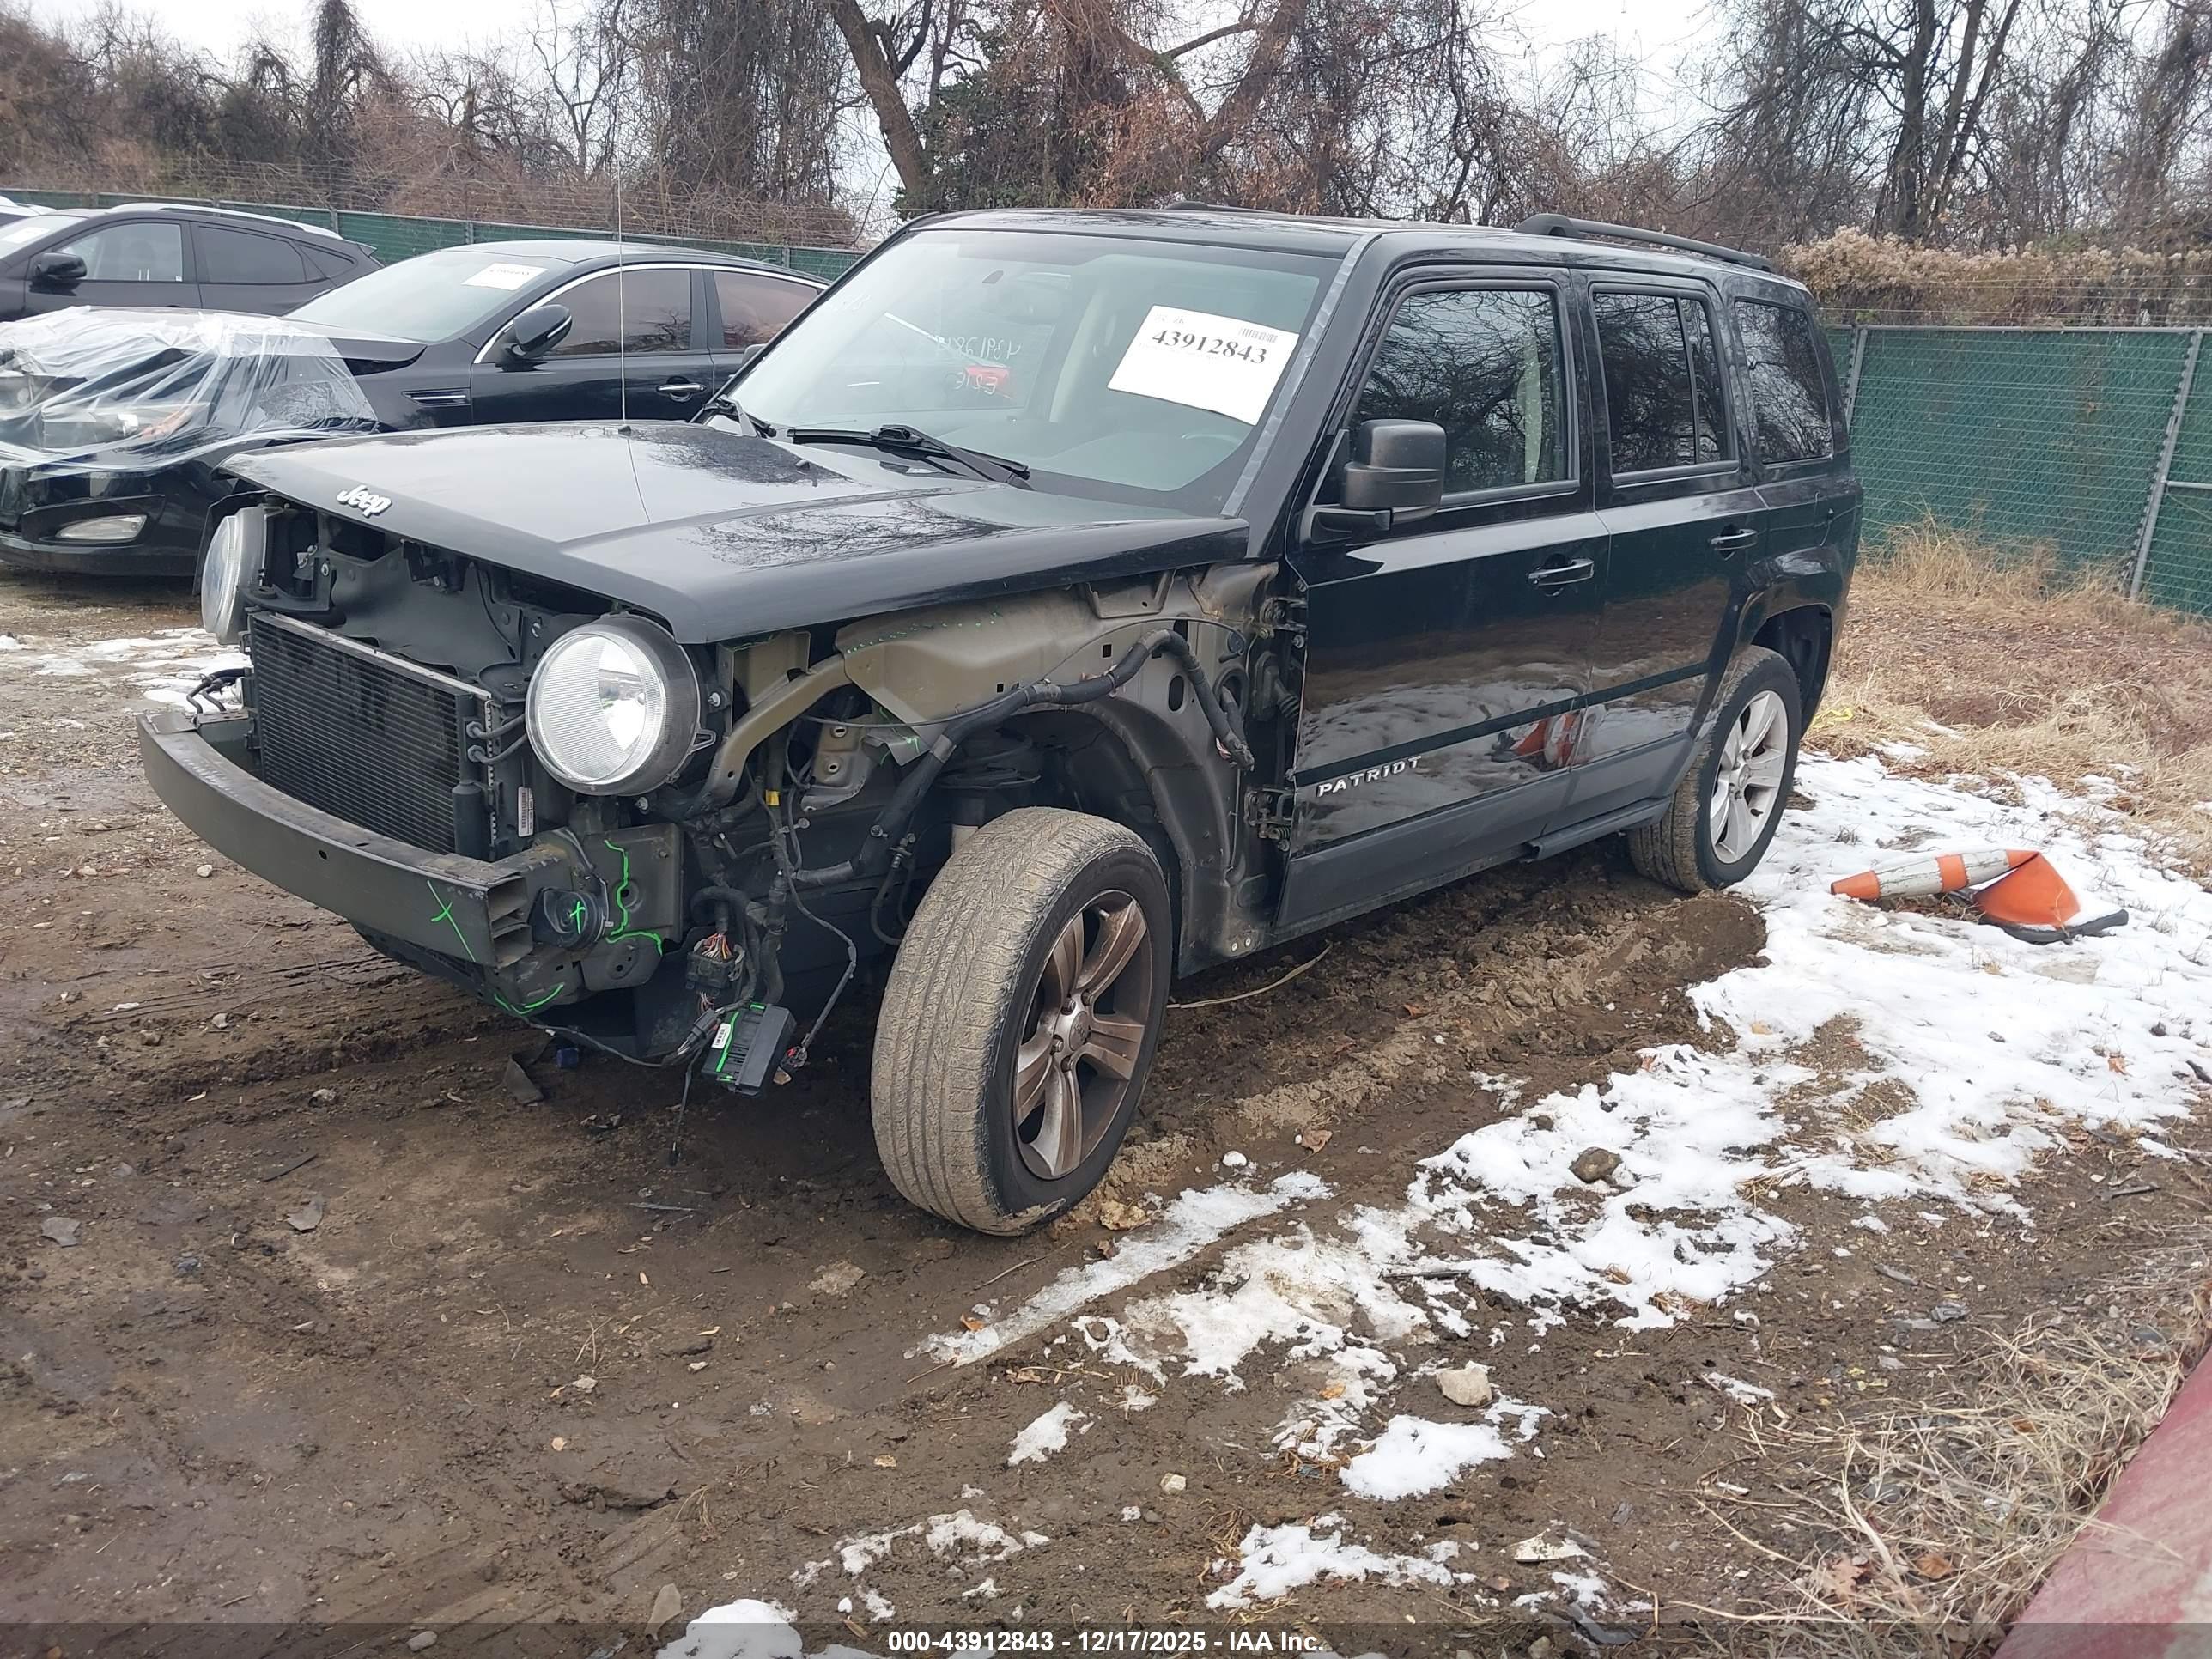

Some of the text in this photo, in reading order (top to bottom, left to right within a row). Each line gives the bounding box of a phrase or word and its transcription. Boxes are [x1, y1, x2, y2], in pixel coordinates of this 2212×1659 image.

[1152, 330, 1267, 363] 43912843
[336, 484, 392, 518] Jeep
[1317, 756, 1422, 797] PATRIOT
